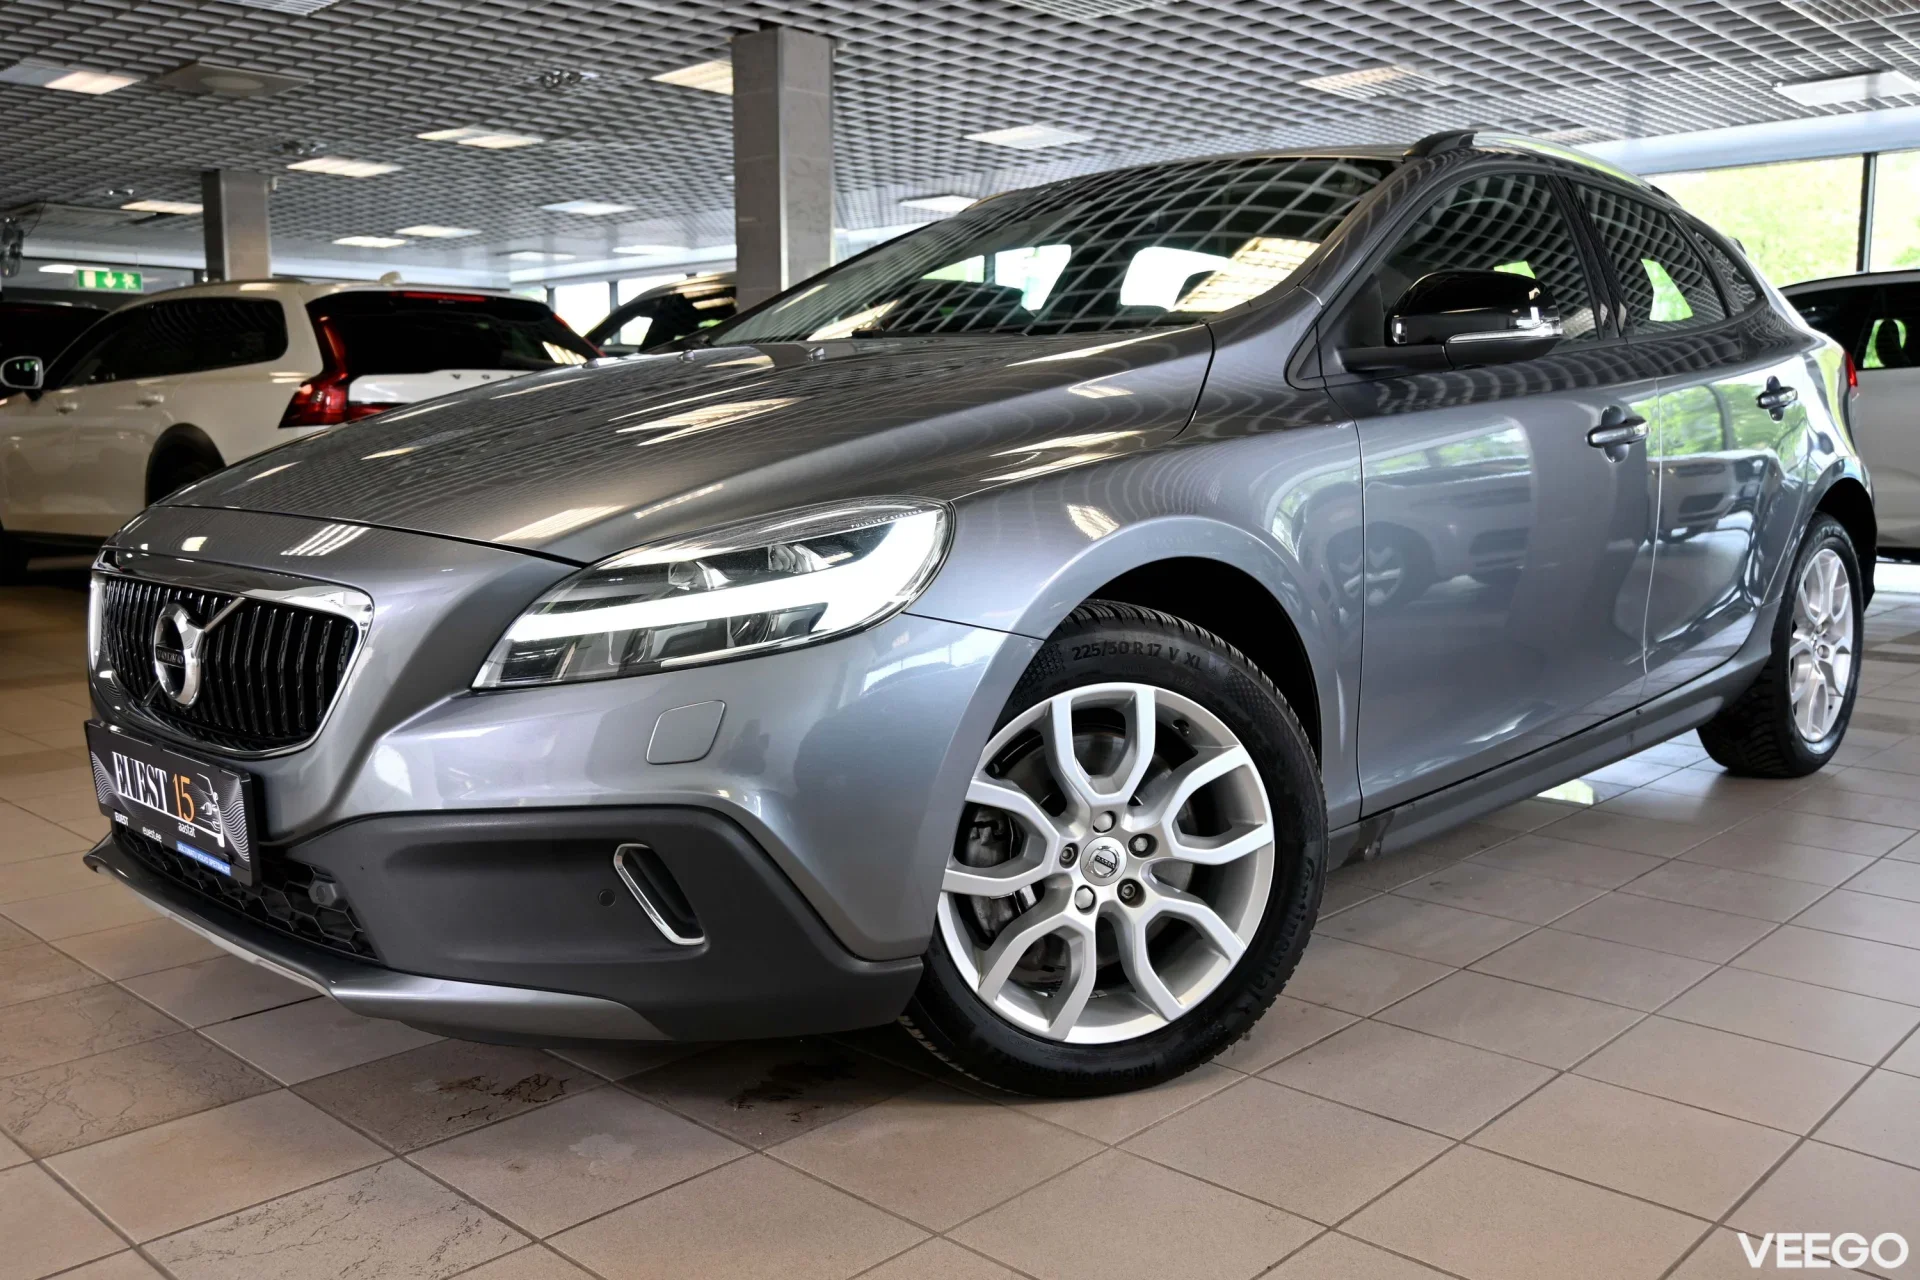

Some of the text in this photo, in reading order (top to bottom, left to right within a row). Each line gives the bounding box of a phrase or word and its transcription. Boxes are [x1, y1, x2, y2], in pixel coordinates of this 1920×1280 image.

[156, 649, 184, 665] VOLVO
[1071, 639, 1201, 671] 225/50 R 17 V XL
[111, 751, 195, 823] EUEST 15
